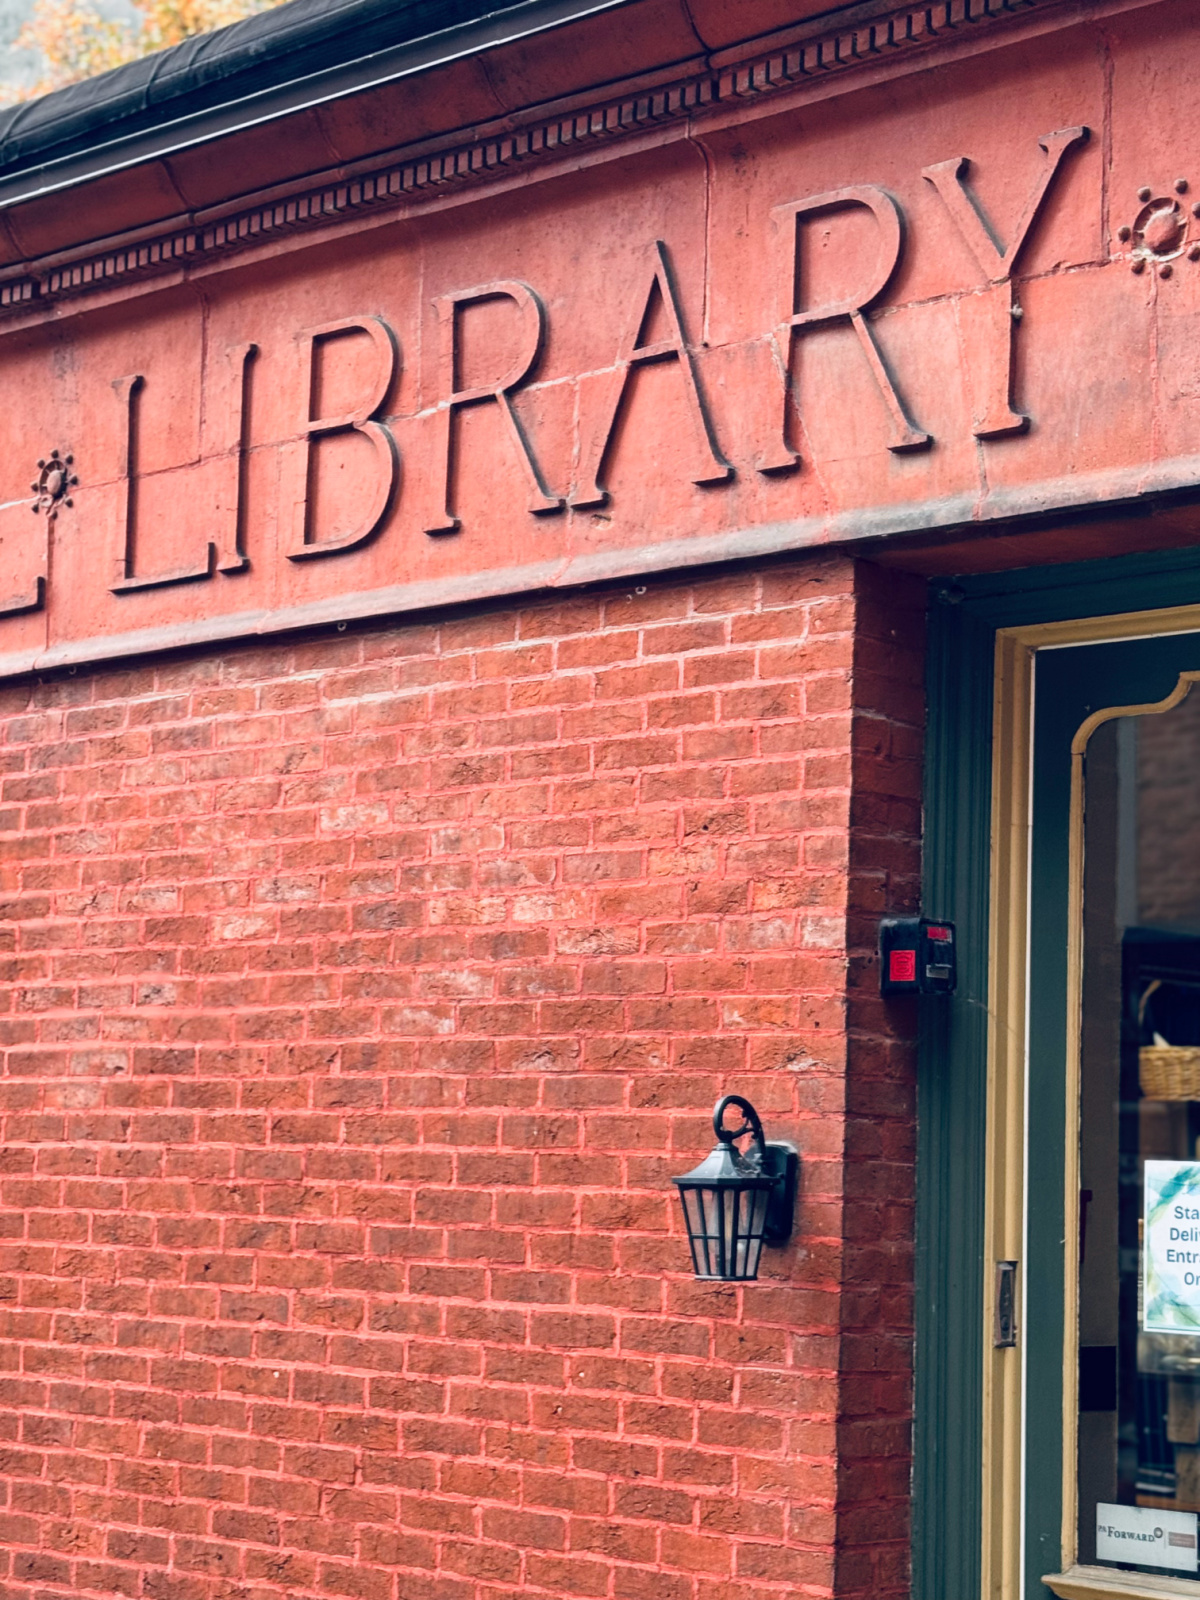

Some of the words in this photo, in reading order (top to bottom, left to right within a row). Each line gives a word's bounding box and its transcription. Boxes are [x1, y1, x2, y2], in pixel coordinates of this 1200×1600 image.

[109, 126, 1091, 595] LIBRARY
[1169, 1227, 1200, 1242] Deli
[1166, 1248, 1200, 1264] Entr
